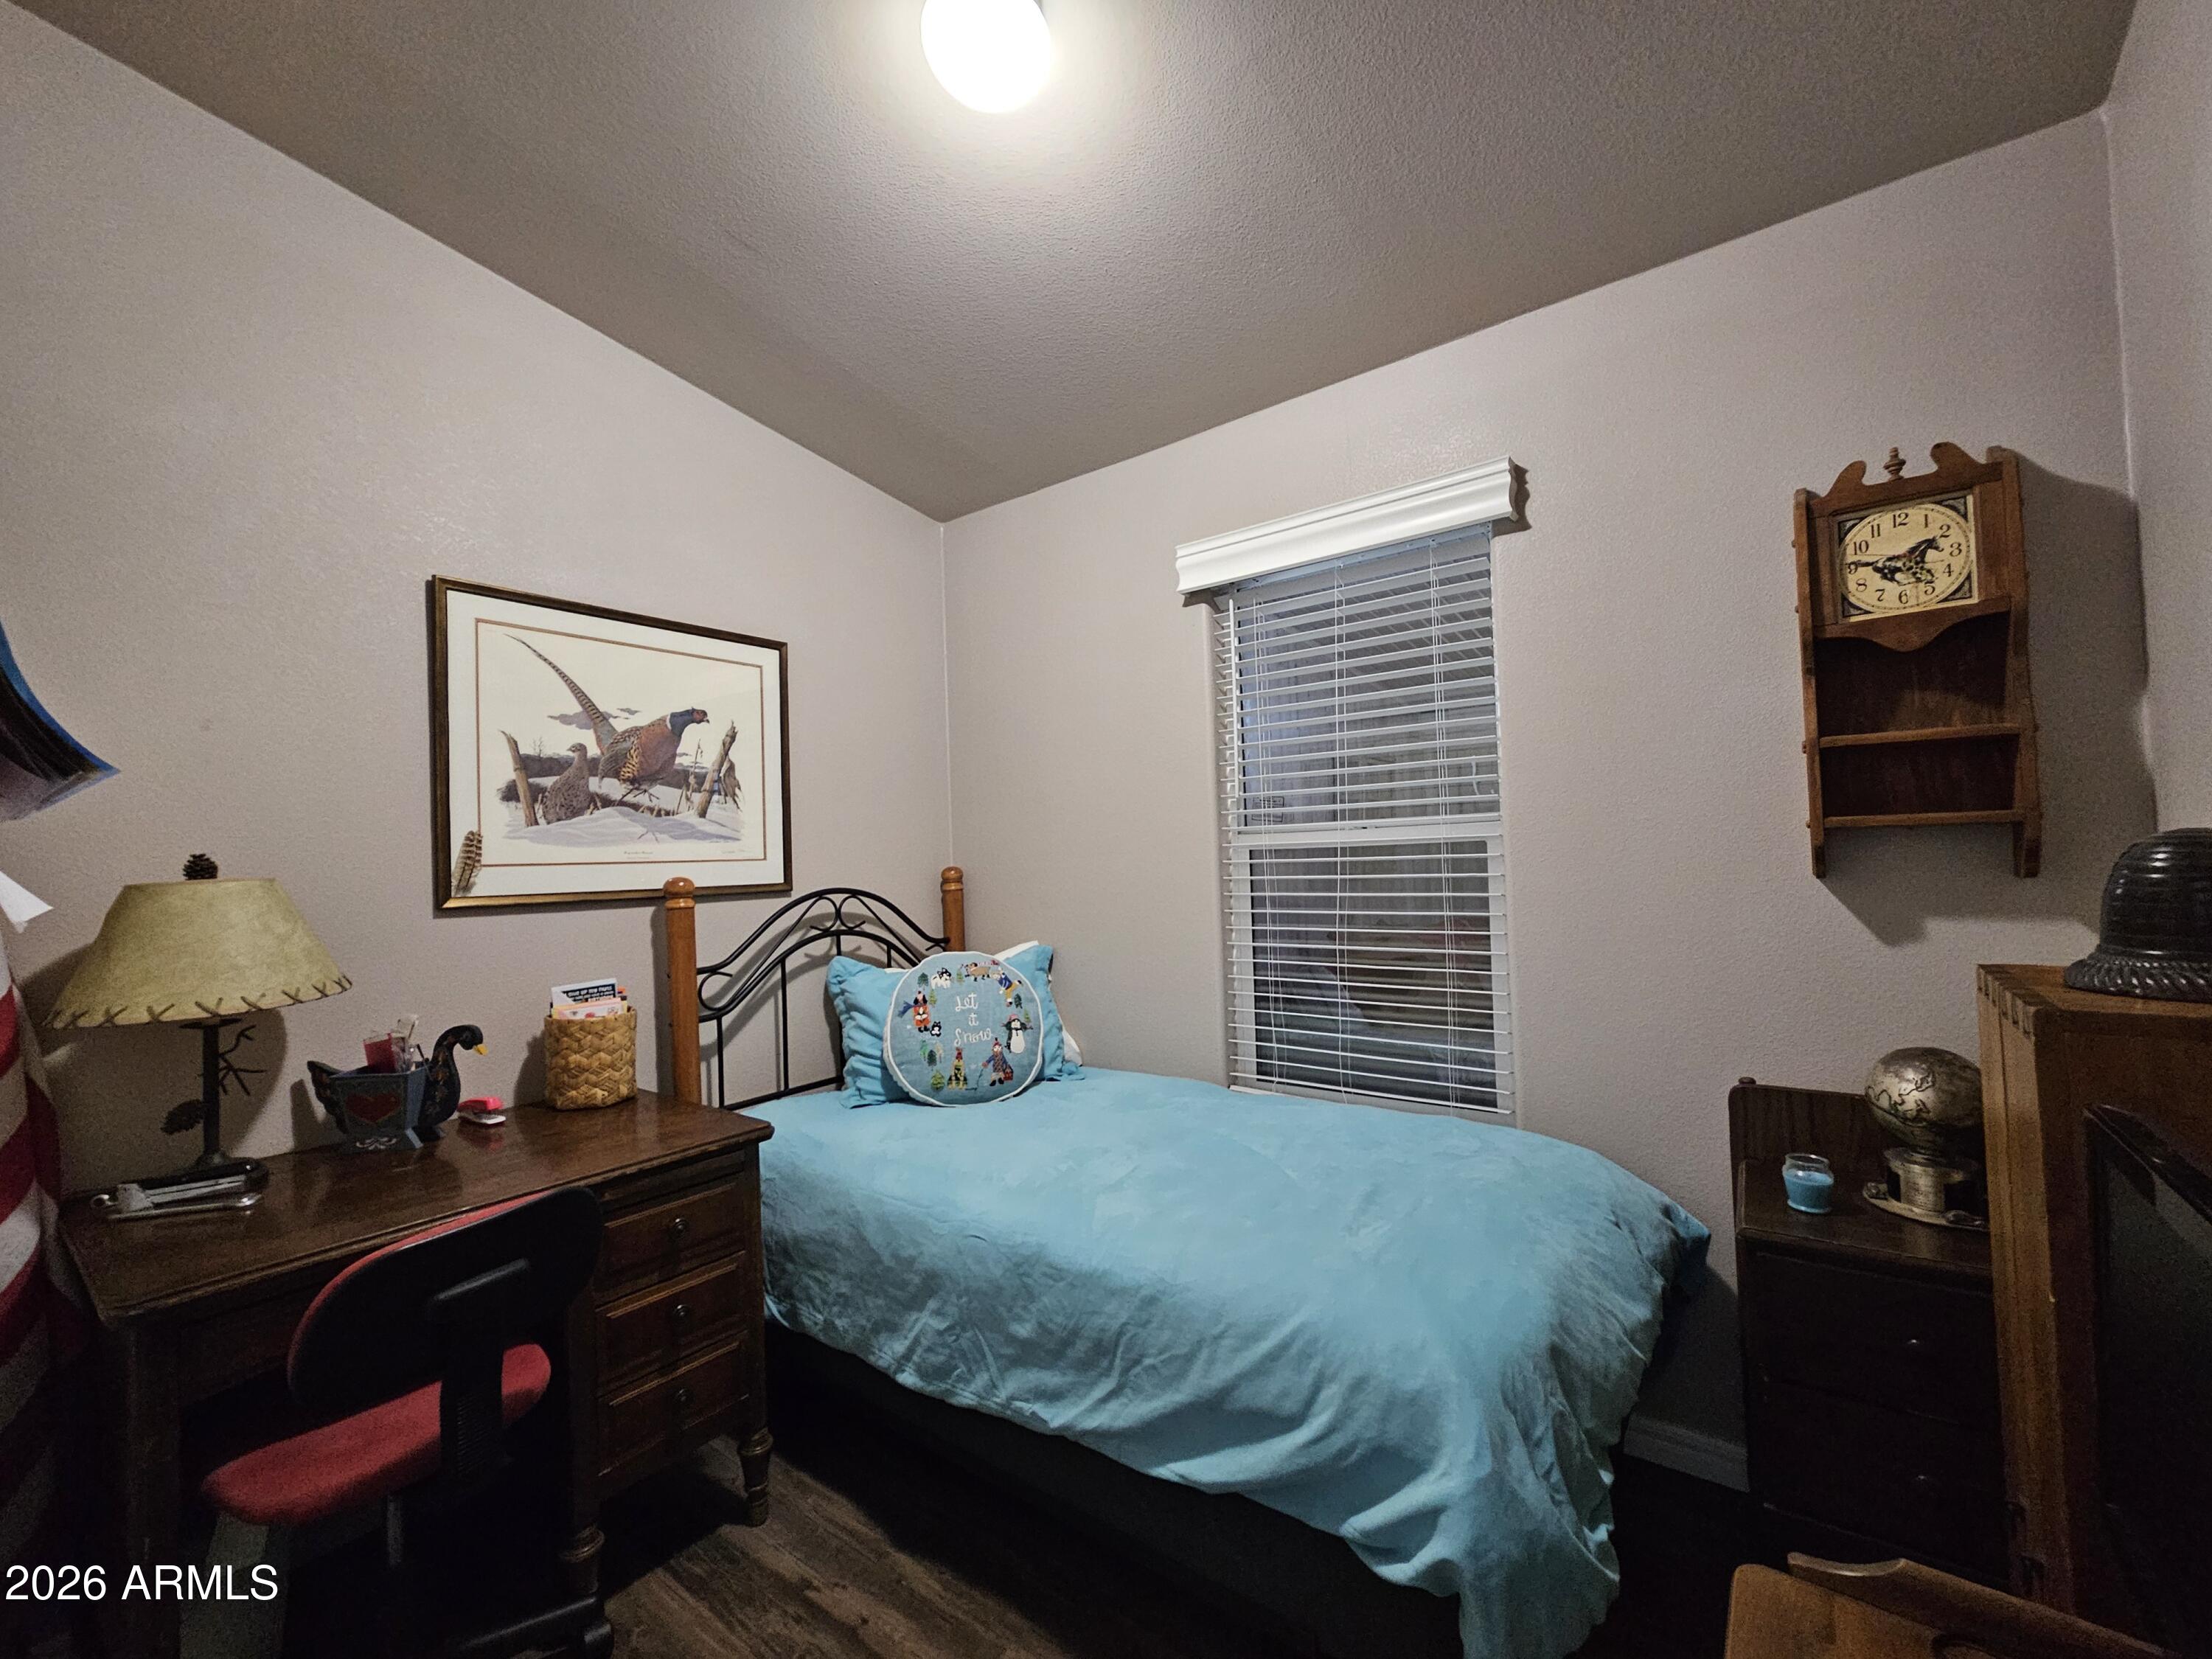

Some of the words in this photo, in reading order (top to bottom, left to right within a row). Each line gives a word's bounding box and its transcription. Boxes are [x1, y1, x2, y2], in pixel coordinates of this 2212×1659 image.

[1892, 512, 1909, 529] 12
[1923, 514, 1929, 529] 1
[1871, 524, 1881, 538] 11
[1939, 524, 1952, 538] 2
[1853, 540, 1869, 555] 10
[1949, 542, 1962, 557] 3
[1943, 563, 1954, 577] 4
[1855, 577, 1868, 593] 8
[1924, 580, 1935, 596] 5
[1875, 588, 1885, 602] 7
[1898, 590, 1909, 605] 6
[955, 992, 978, 1012] Let
[968, 1012, 978, 1026] it
[954, 1028, 992, 1047] Snow
